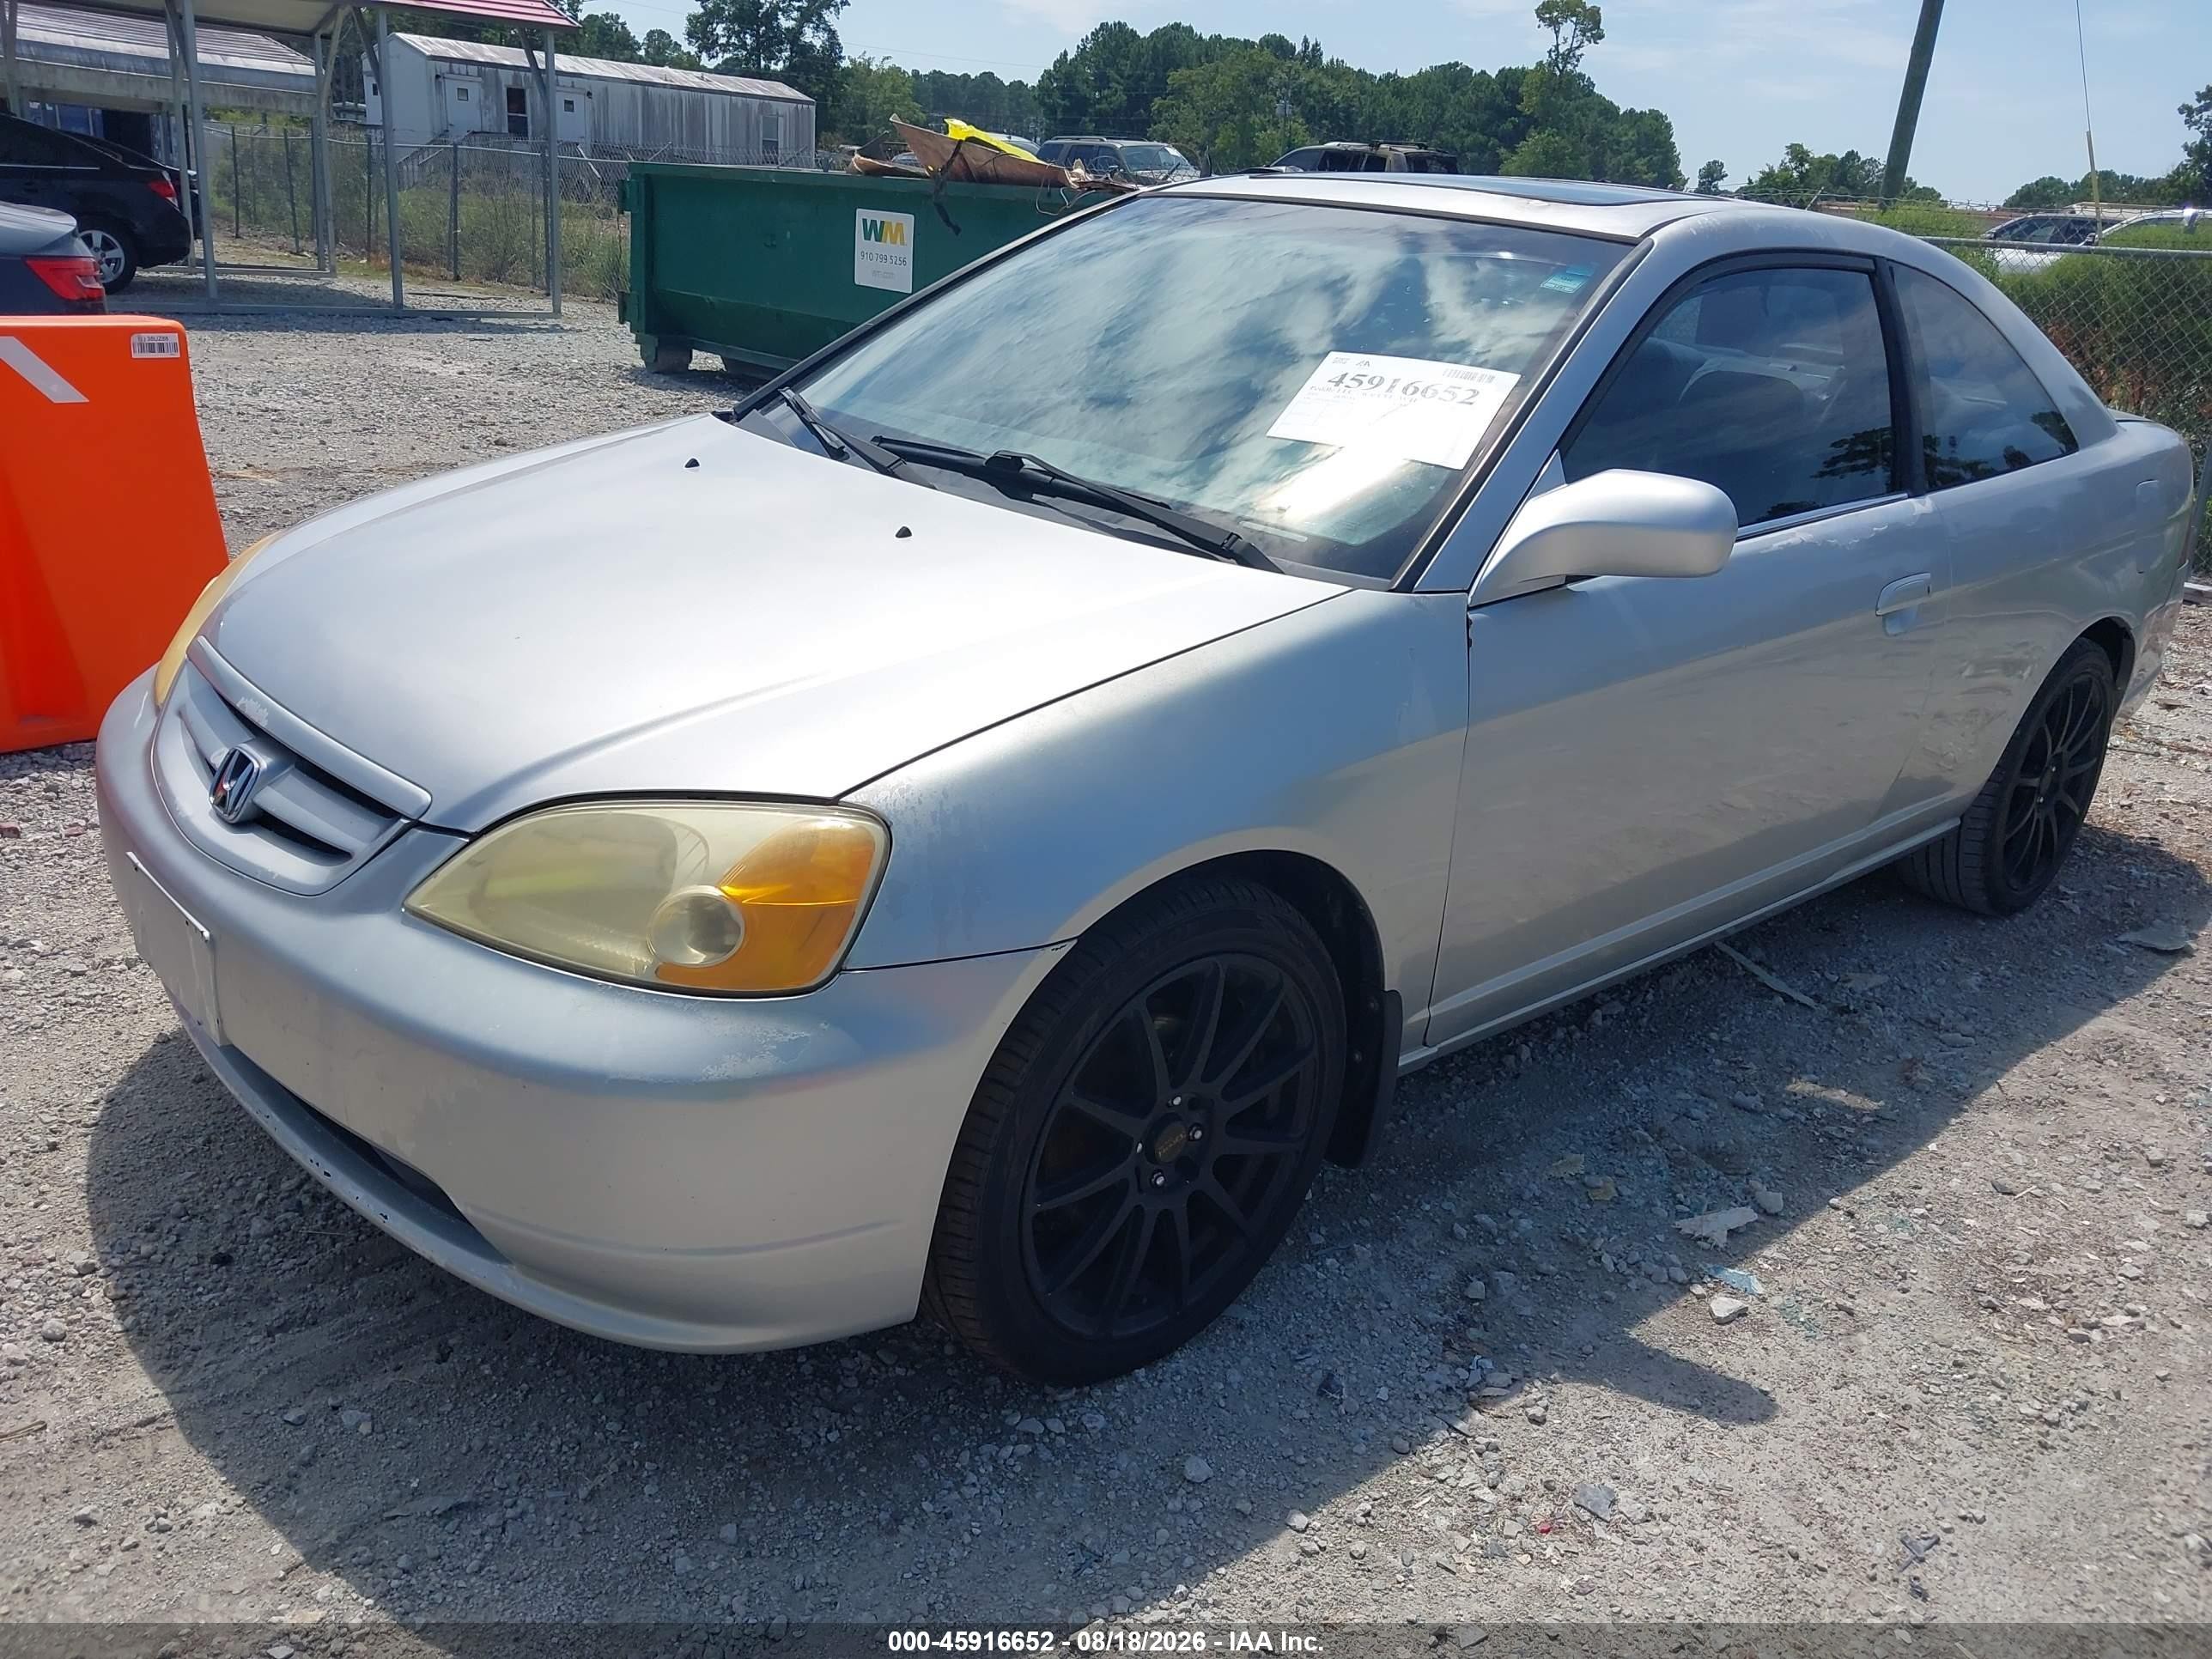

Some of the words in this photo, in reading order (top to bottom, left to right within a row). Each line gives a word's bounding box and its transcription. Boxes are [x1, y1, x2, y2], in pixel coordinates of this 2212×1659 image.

[862, 218, 905, 246] WM
[860, 251, 873, 261] 910
[875, 252, 888, 264] 799
[890, 255, 907, 266] 5256
[1328, 372, 1480, 405] 45916652
